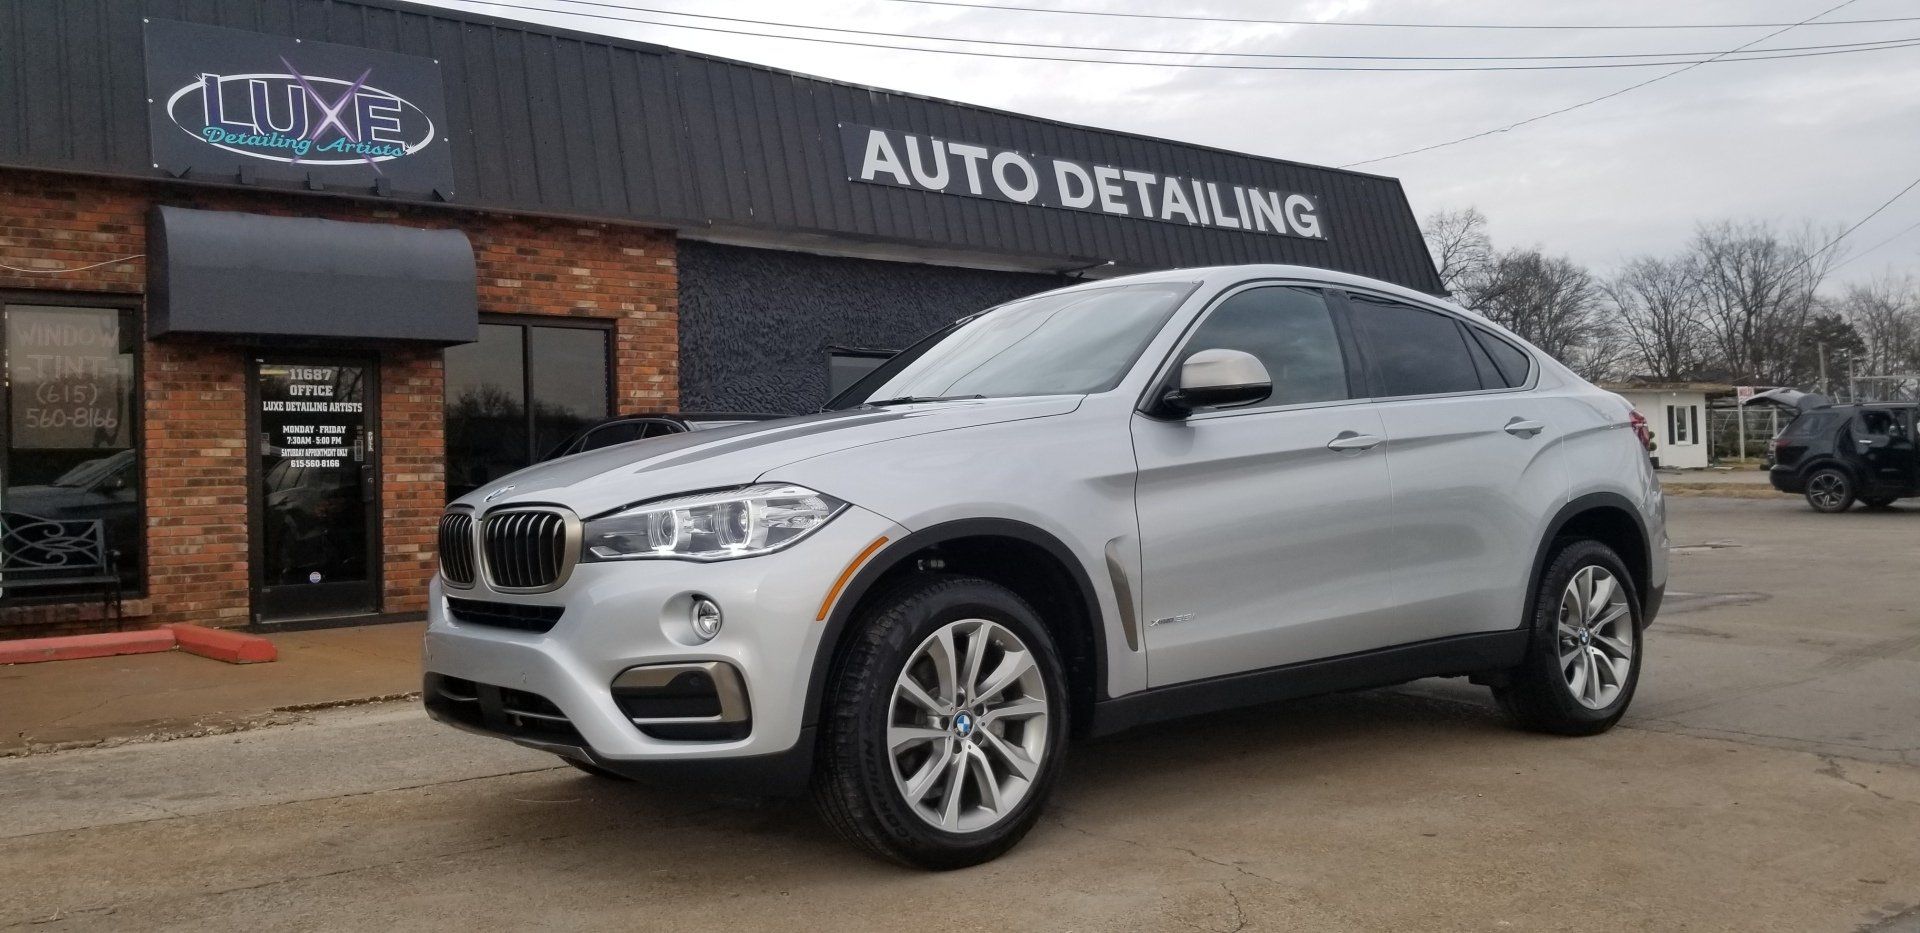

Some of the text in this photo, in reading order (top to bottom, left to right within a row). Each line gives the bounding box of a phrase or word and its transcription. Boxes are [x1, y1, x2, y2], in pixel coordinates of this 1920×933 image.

[201, 62, 407, 154] LUXE
[202, 126, 408, 158] Detailing Artists
[860, 129, 1322, 239] AUTO DETAILING
[289, 368, 332, 381] 11687
[36, 382, 98, 406] (615)
[289, 384, 334, 397] OFFICE
[263, 401, 363, 413] LUXE DETAILING ARTISTS
[26, 407, 118, 429] 560-8166
[282, 425, 315, 434] MONDAY
[319, 425, 347, 434] FRIDAY
[286, 436, 312, 445] 7:30AM
[315, 436, 331, 445] 5:00
[331, 436, 342, 445] PM
[281, 448, 348, 457] SATURDAY APPOINTMENT ONLY
[290, 459, 340, 468] 615-560-8166
